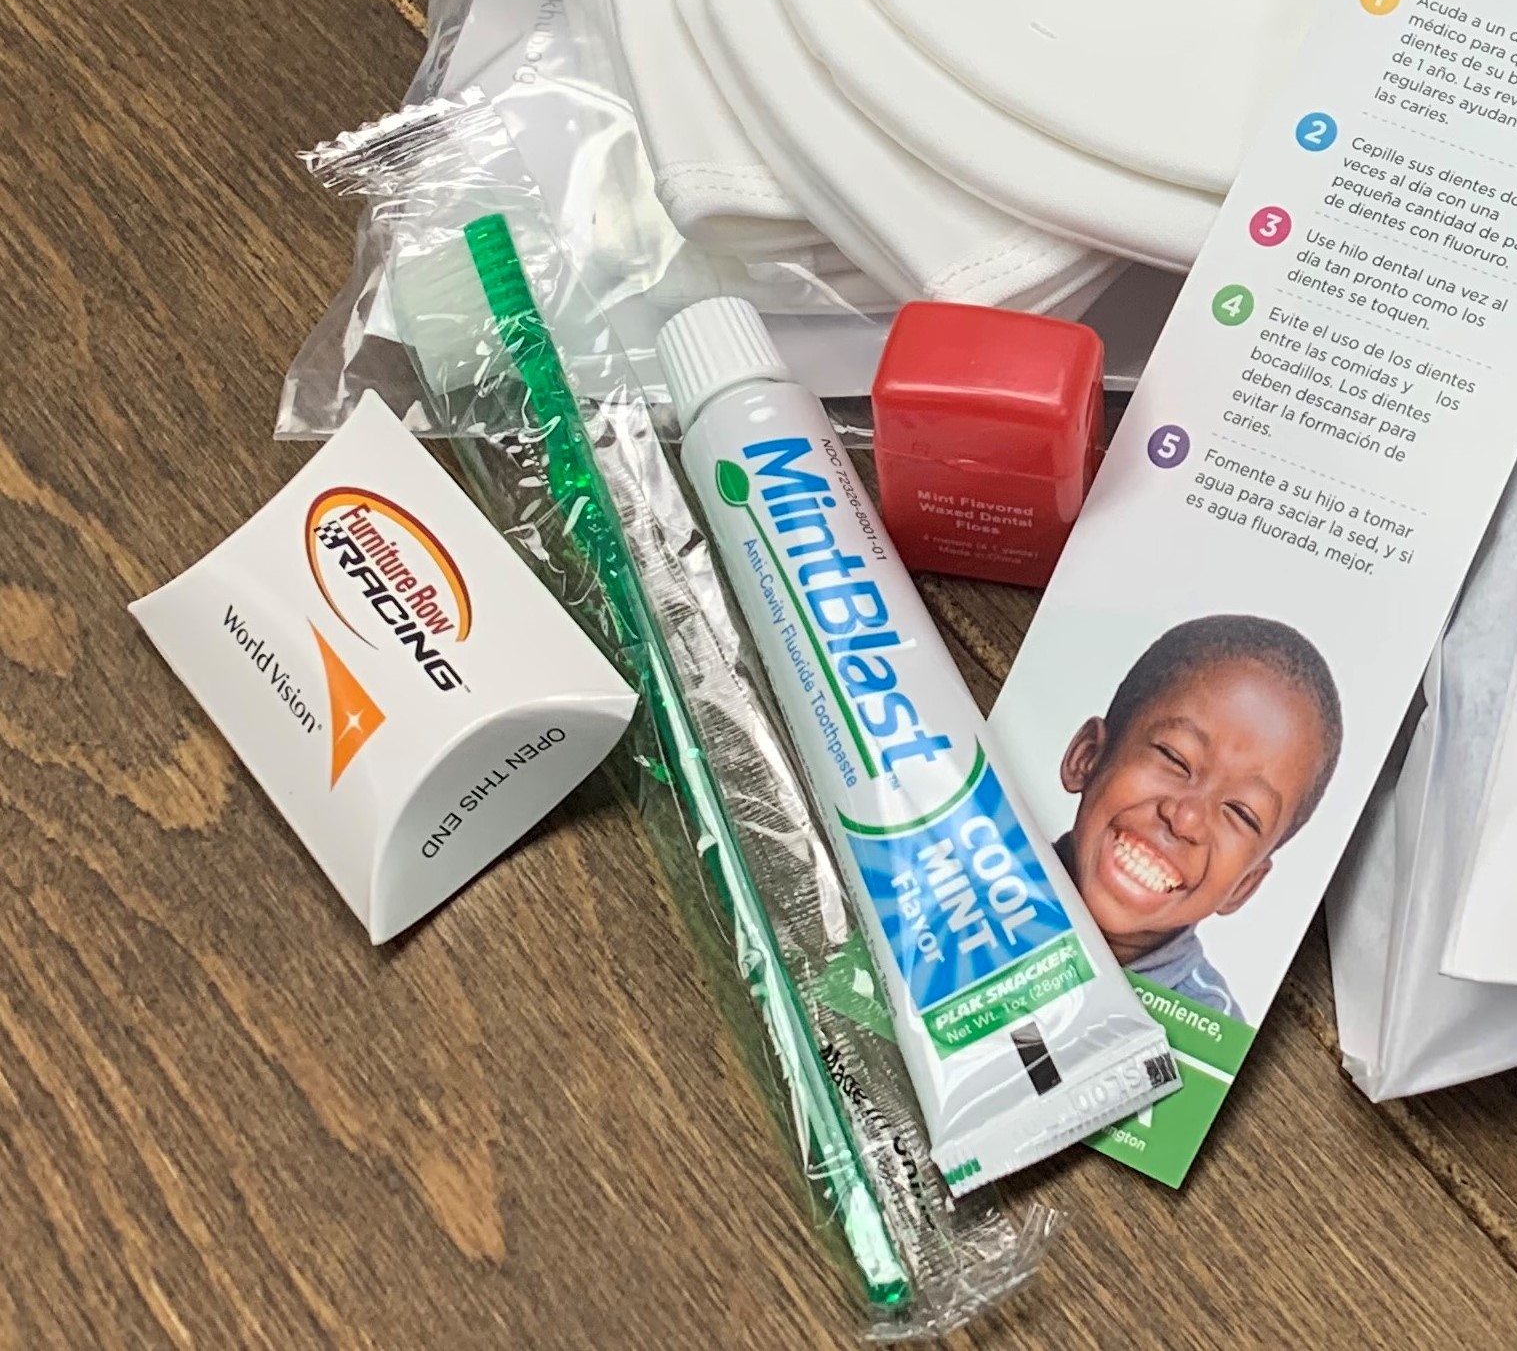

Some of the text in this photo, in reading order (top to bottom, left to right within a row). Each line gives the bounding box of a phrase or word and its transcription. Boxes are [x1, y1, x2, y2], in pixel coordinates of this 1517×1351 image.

[1408, 13, 1467, 45] médico
[1469, 38, 1506, 59] para
[1471, 16, 1482, 28] a
[1486, 21, 1506, 37] un
[1374, 86, 1449, 125] las caries.
[1382, 69, 1456, 105] regulares
[1458, 99, 1517, 127] ayudan
[1392, 51, 1413, 67] de
[1417, 59, 1424, 72] 1
[1426, 62, 1458, 85] año.
[1463, 76, 1491, 97] Las
[1304, 120, 1328, 145] 2
[1343, 157, 1500, 221] veces al día con una
[1351, 137, 1405, 165] Cepille
[1408, 158, 1435, 177] sus
[1438, 169, 1496, 199] dientes
[1259, 213, 1282, 238] 3
[1324, 193, 1509, 269] de dientes con fluoruro.
[1332, 175, 1402, 208] pequeña
[1405, 201, 1476, 234] cantidad
[1479, 225, 1500, 243] de
[1287, 268, 1430, 331] dientes se toquen.
[1296, 249, 1486, 328] día tan pronto como los
[1306, 229, 1508, 313] Use hilo dental una vez al
[1220, 293, 1244, 317] 4
[1241, 367, 1417, 442] deben descansar para
[1250, 345, 1432, 424] bocadillos. Los dientes
[821, 438, 842, 467] NDC
[1156, 433, 1181, 459] 5
[1223, 409, 1272, 437] caries.
[1232, 388, 1406, 463] evitar la formación de
[917, 490, 1033, 516] Mint Flavored
[920, 502, 1032, 528] Waxed Dental
[956, 520, 1000, 534] Floss
[1186, 492, 1374, 575] es agua fluorada, mejor.
[339, 502, 455, 635] Furniture Row
[329, 538, 463, 692] RACING
[742, 437, 952, 773] MintBlast
[222, 605, 316, 734] World Vision
[743, 538, 858, 788] Anti-Cavity Fluoride Toothpaste
[421, 727, 566, 859] OPEN THIS END
[918, 837, 999, 955] MINT
[959, 815, 1038, 946] COOL
[890, 870, 946, 964] Flavor
[935, 995, 985, 1031] PLAK
[946, 1024, 972, 1044] Net
[973, 1013, 999, 1029] Wt.
